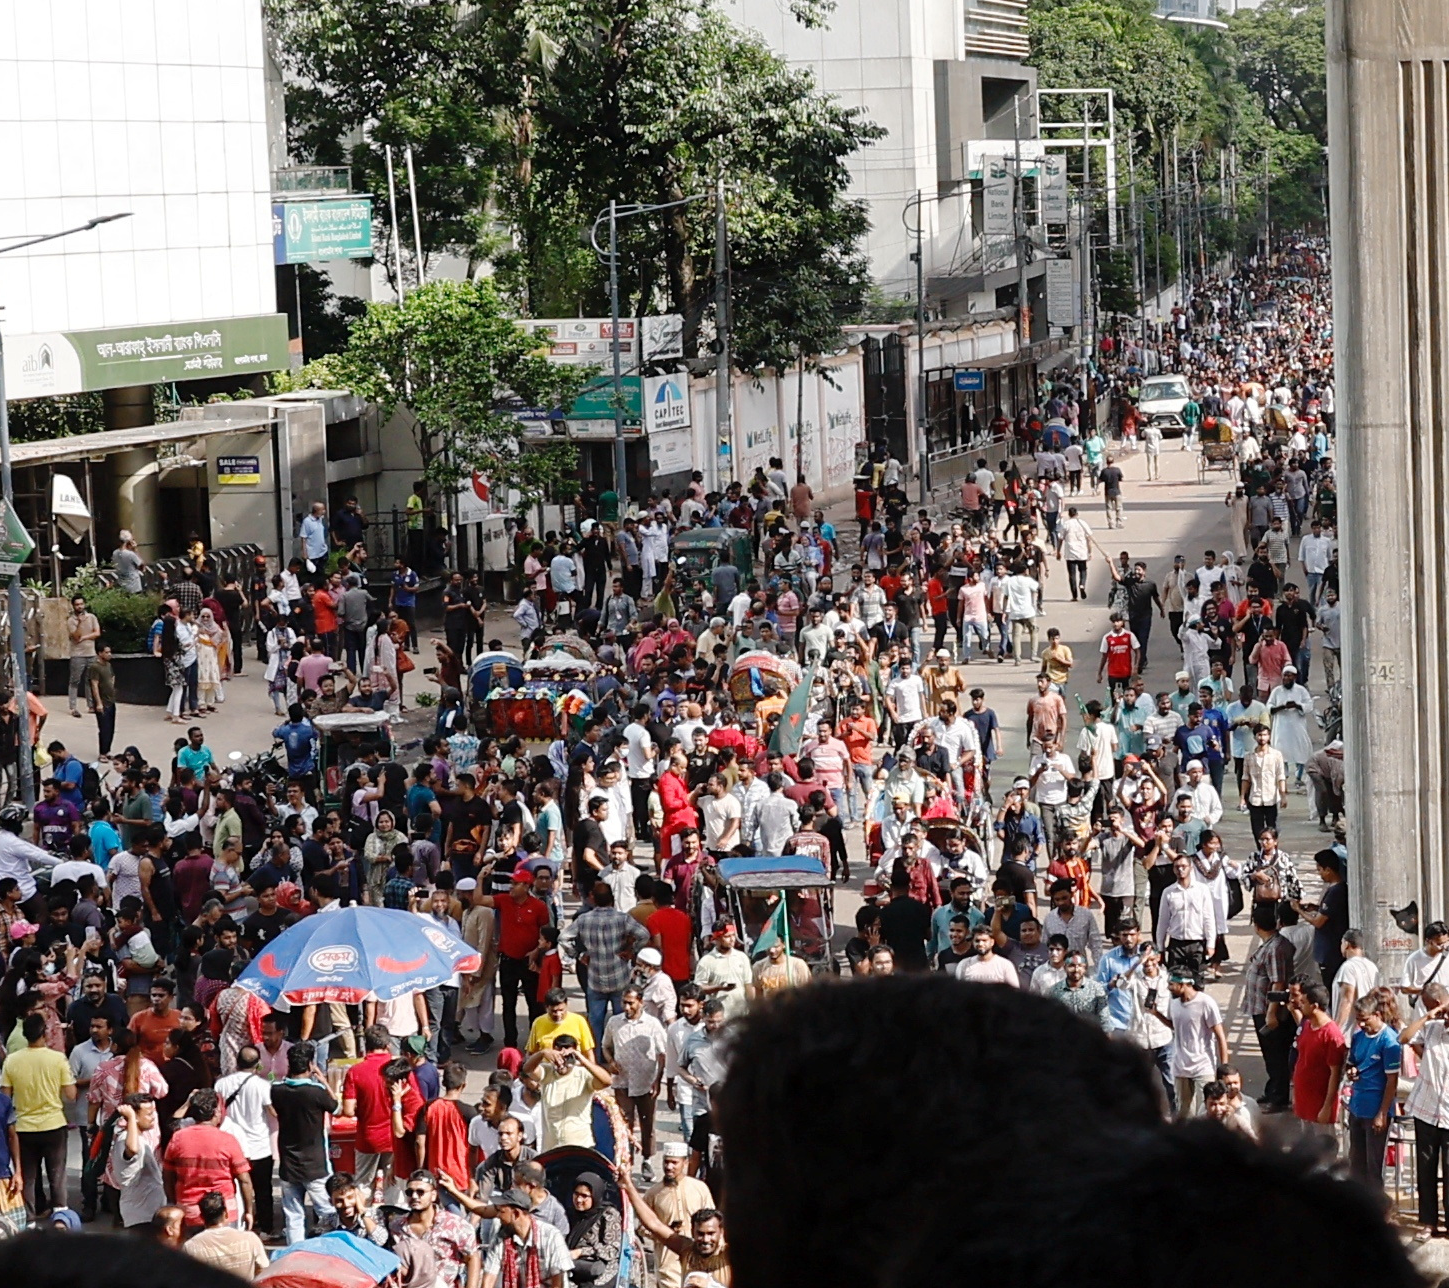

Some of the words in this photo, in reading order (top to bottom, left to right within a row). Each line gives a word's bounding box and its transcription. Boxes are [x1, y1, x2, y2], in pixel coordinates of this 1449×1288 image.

[987, 187, 1010, 196] National
[990, 200, 1005, 208] Bank
[987, 212, 1008, 221] Limited
